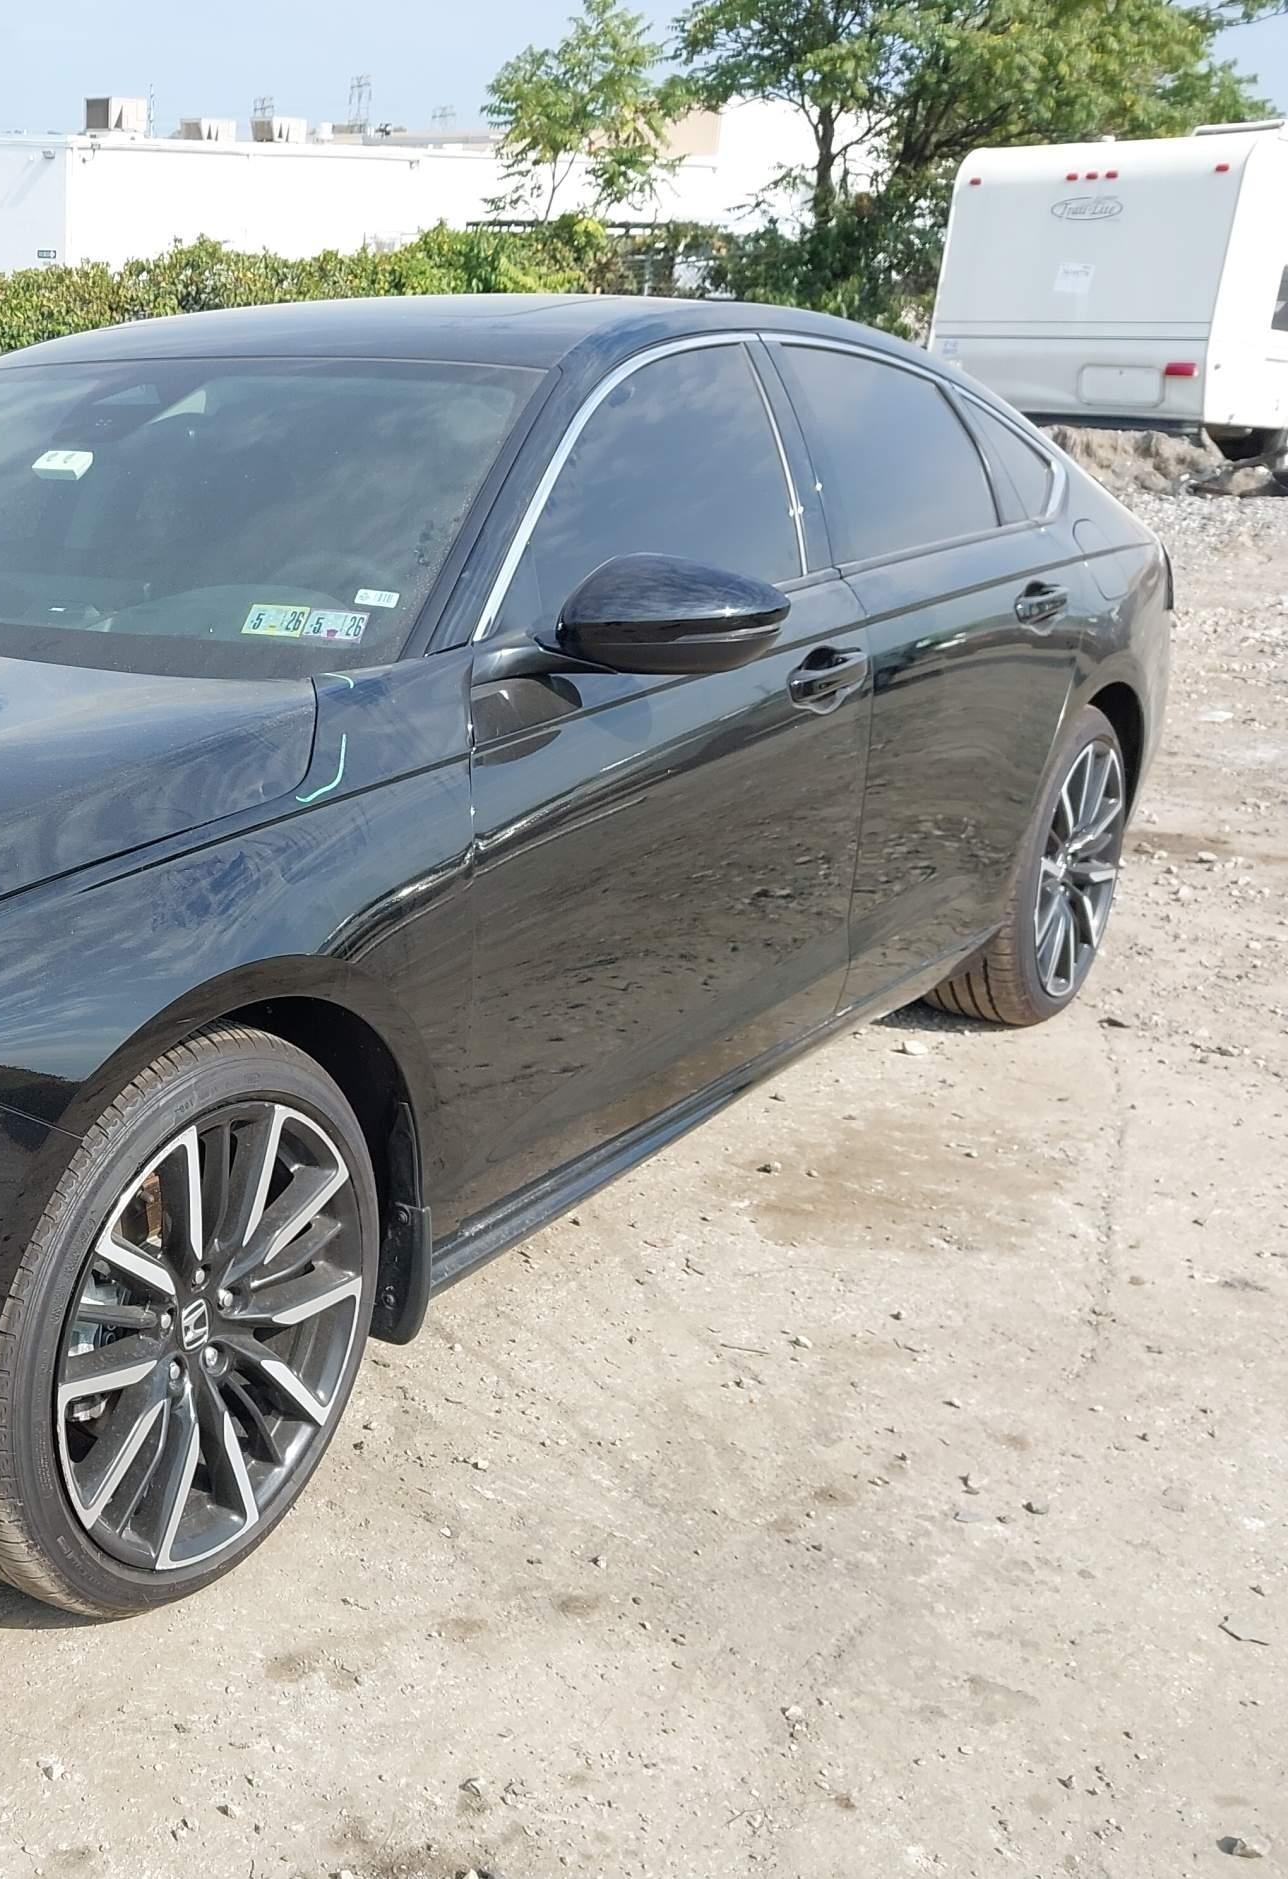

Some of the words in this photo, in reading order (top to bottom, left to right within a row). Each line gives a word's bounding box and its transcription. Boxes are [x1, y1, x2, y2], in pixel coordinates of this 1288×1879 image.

[253, 612, 265, 630] 5
[285, 611, 305, 633] 26
[312, 616, 325, 634] 5
[345, 615, 365, 637] 26
